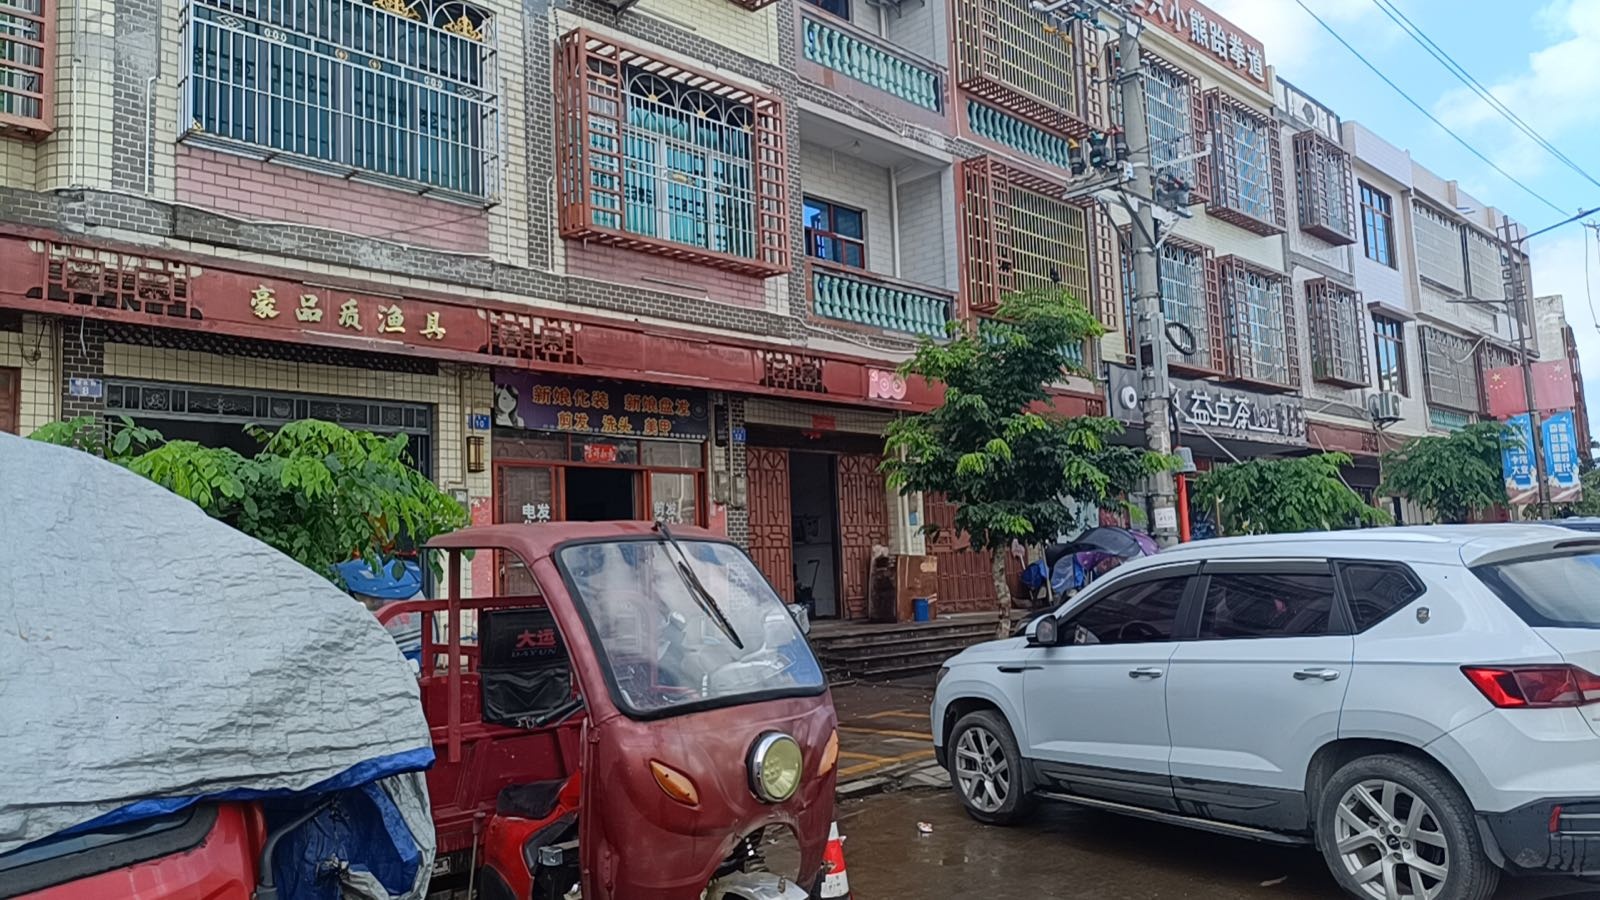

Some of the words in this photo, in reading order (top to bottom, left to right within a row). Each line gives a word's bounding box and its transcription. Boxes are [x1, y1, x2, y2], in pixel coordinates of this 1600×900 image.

[250, 284, 446, 340] 豪品质渔具
[532, 384, 609, 410] 新娘化装
[624, 393, 691, 417] 新娘盘发
[557, 410, 590, 431] 剪发
[601, 414, 633, 434] 洗头
[644, 417, 672, 436] 美甲
[522, 503, 551, 519] 电发
[515, 628, 557, 650] 大运
[511, 648, 557, 658] DAYUN
